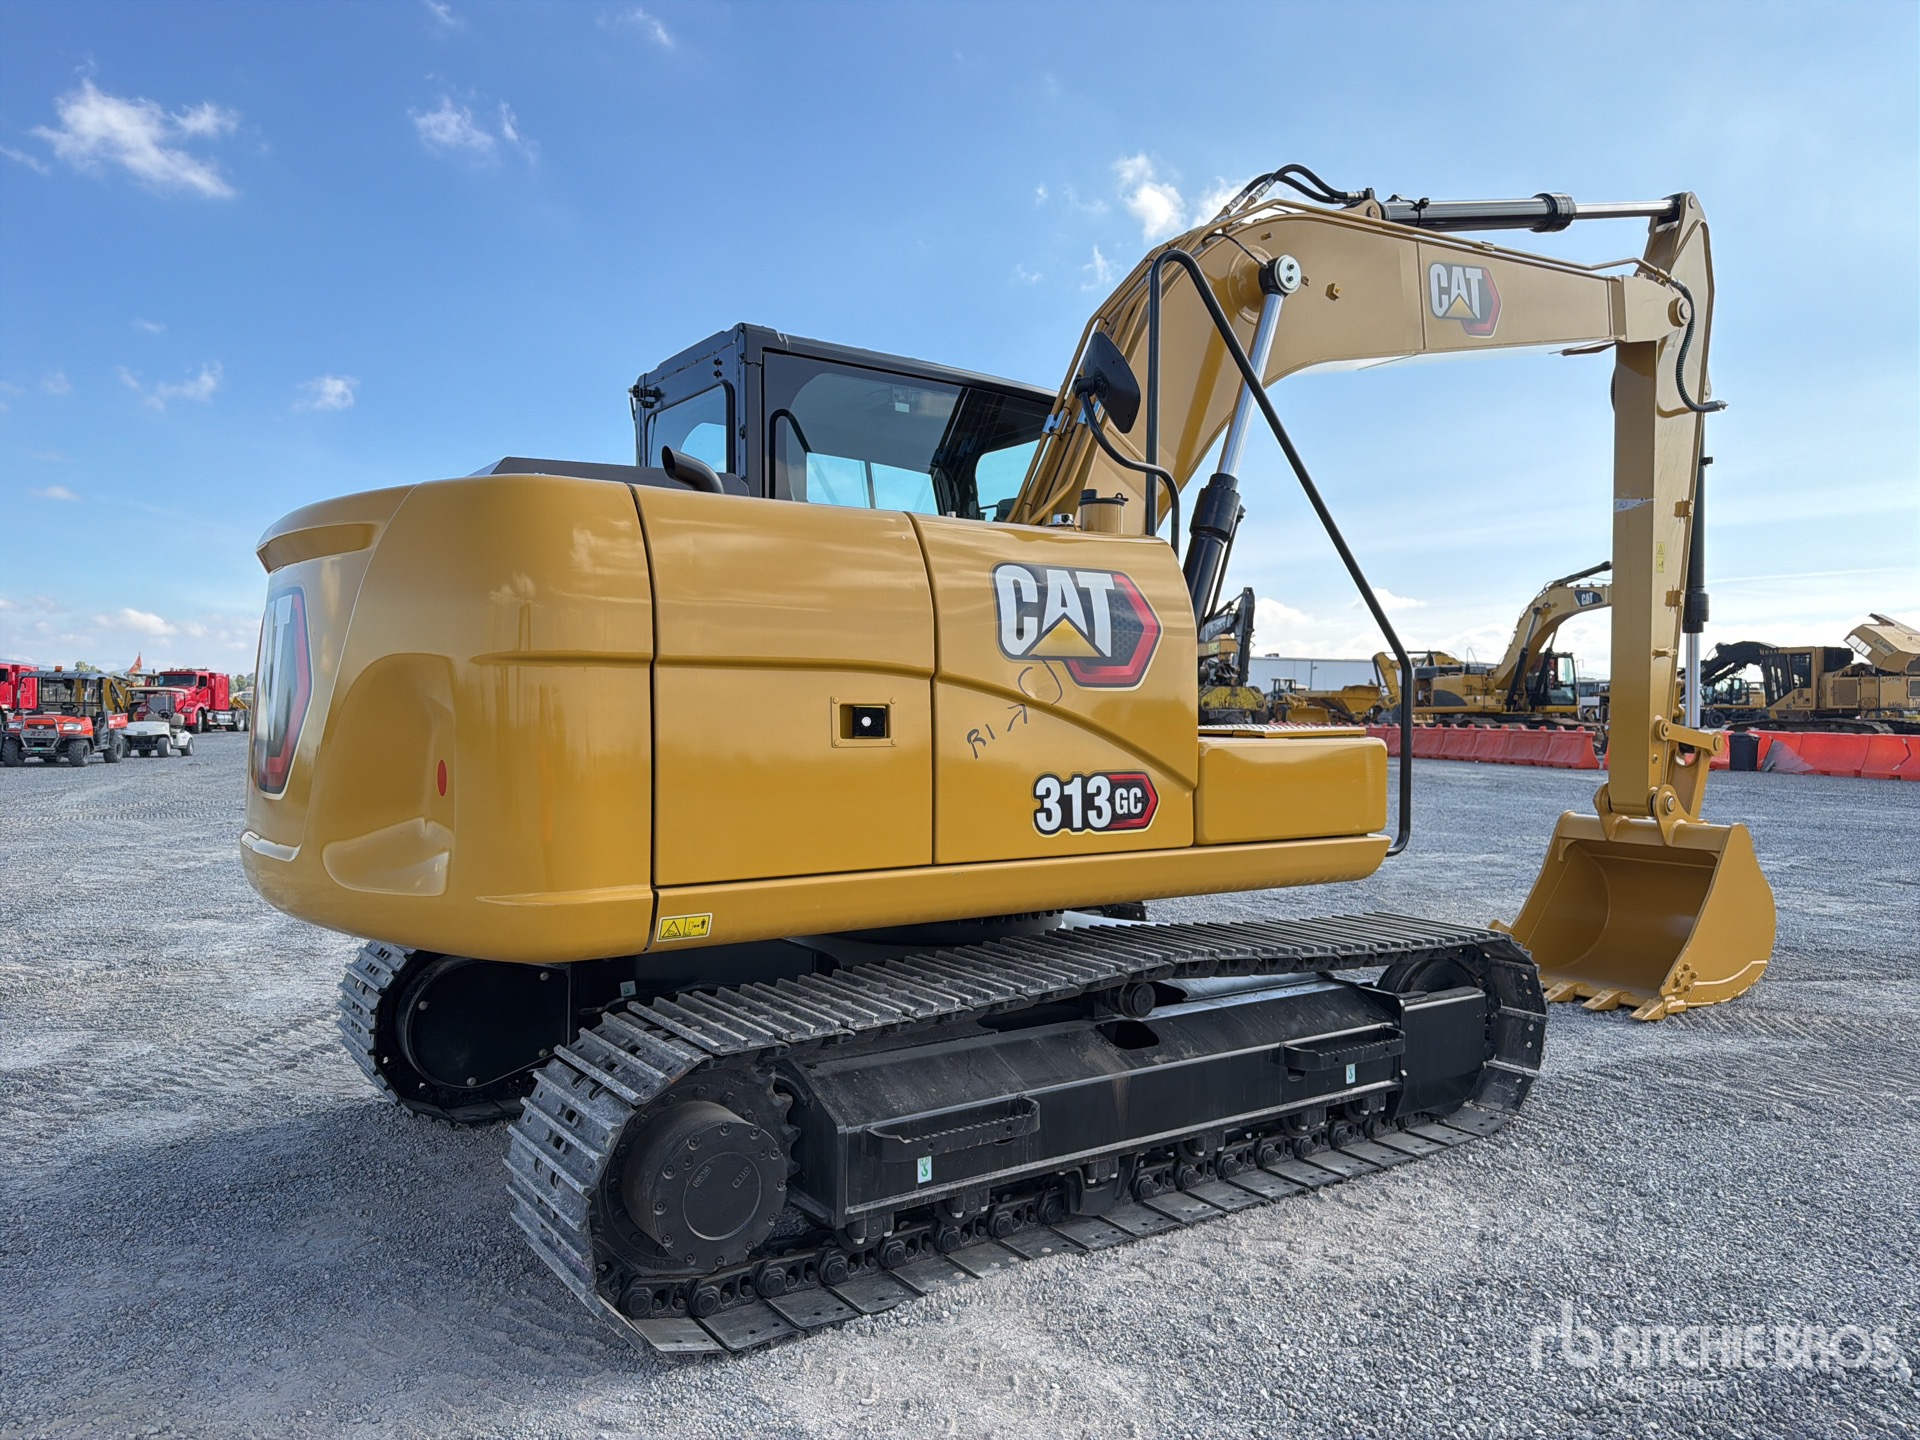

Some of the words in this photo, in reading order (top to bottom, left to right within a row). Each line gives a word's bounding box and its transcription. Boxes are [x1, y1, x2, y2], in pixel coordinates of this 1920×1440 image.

[1430, 263, 1483, 319] CAT
[995, 564, 1115, 658] CAT
[1581, 592, 1593, 606] CAT
[1036, 775, 1112, 831] 313
[1115, 787, 1142, 814] GC
